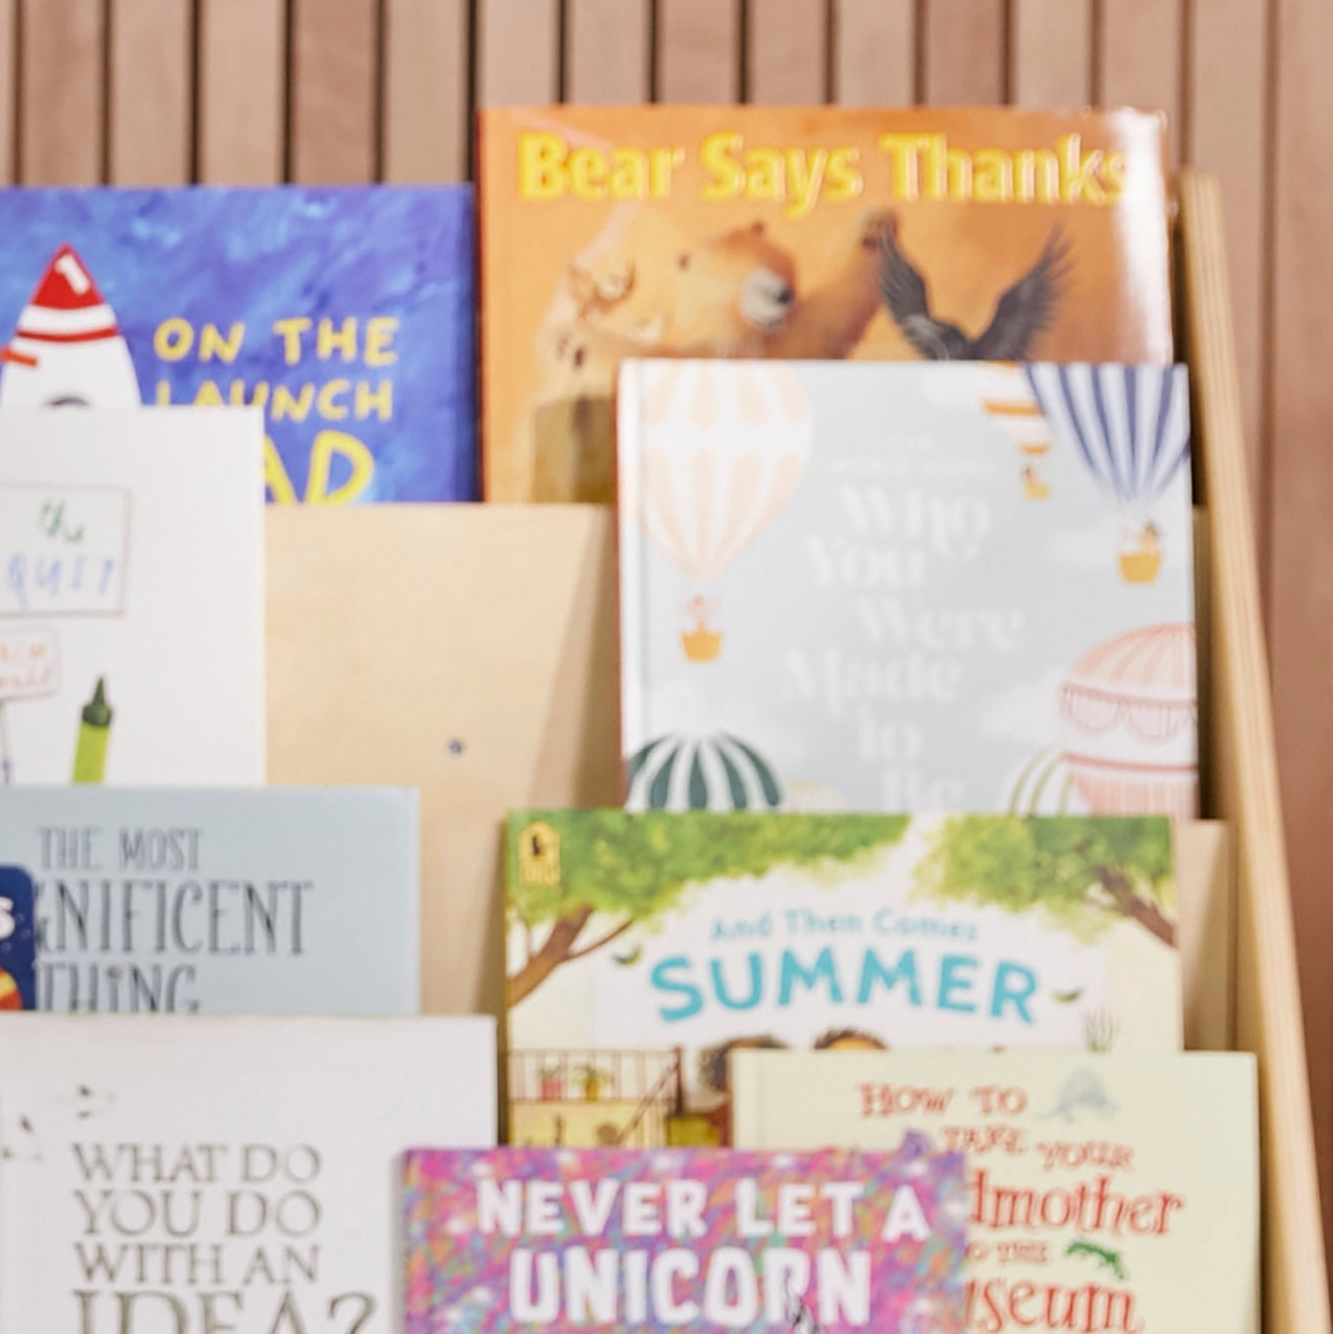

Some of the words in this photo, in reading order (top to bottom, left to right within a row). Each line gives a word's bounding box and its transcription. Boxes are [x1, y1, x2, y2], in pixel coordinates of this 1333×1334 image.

[517, 131, 685, 200] Bear
[701, 131, 861, 218] Says
[153, 316, 245, 364] ON
[272, 316, 401, 368] THE
[9, 551, 116, 610] QUIT
[37, 825, 104, 870] THE
[119, 825, 203, 870] MOST
[712, 917, 777, 944] And
[782, 908, 863, 938] Then
[873, 908, 978, 943] Comes
[649, 947, 1040, 1025] SUMMER
[971, 1083, 1029, 1116] TO
[72, 1143, 232, 1184] WHAT
[239, 1143, 321, 1184] DO
[1035, 1140, 1135, 1171] YOUR
[72, 1189, 203, 1237] YOU
[225, 1189, 322, 1237] DO
[476, 1178, 709, 1239] NEVER
[734, 1176, 864, 1239] LET
[880, 1185, 933, 1243] A
[72, 1242, 225, 1287] WITH
[236, 1242, 321, 1287] AN
[509, 1245, 873, 1327] UNICORN
